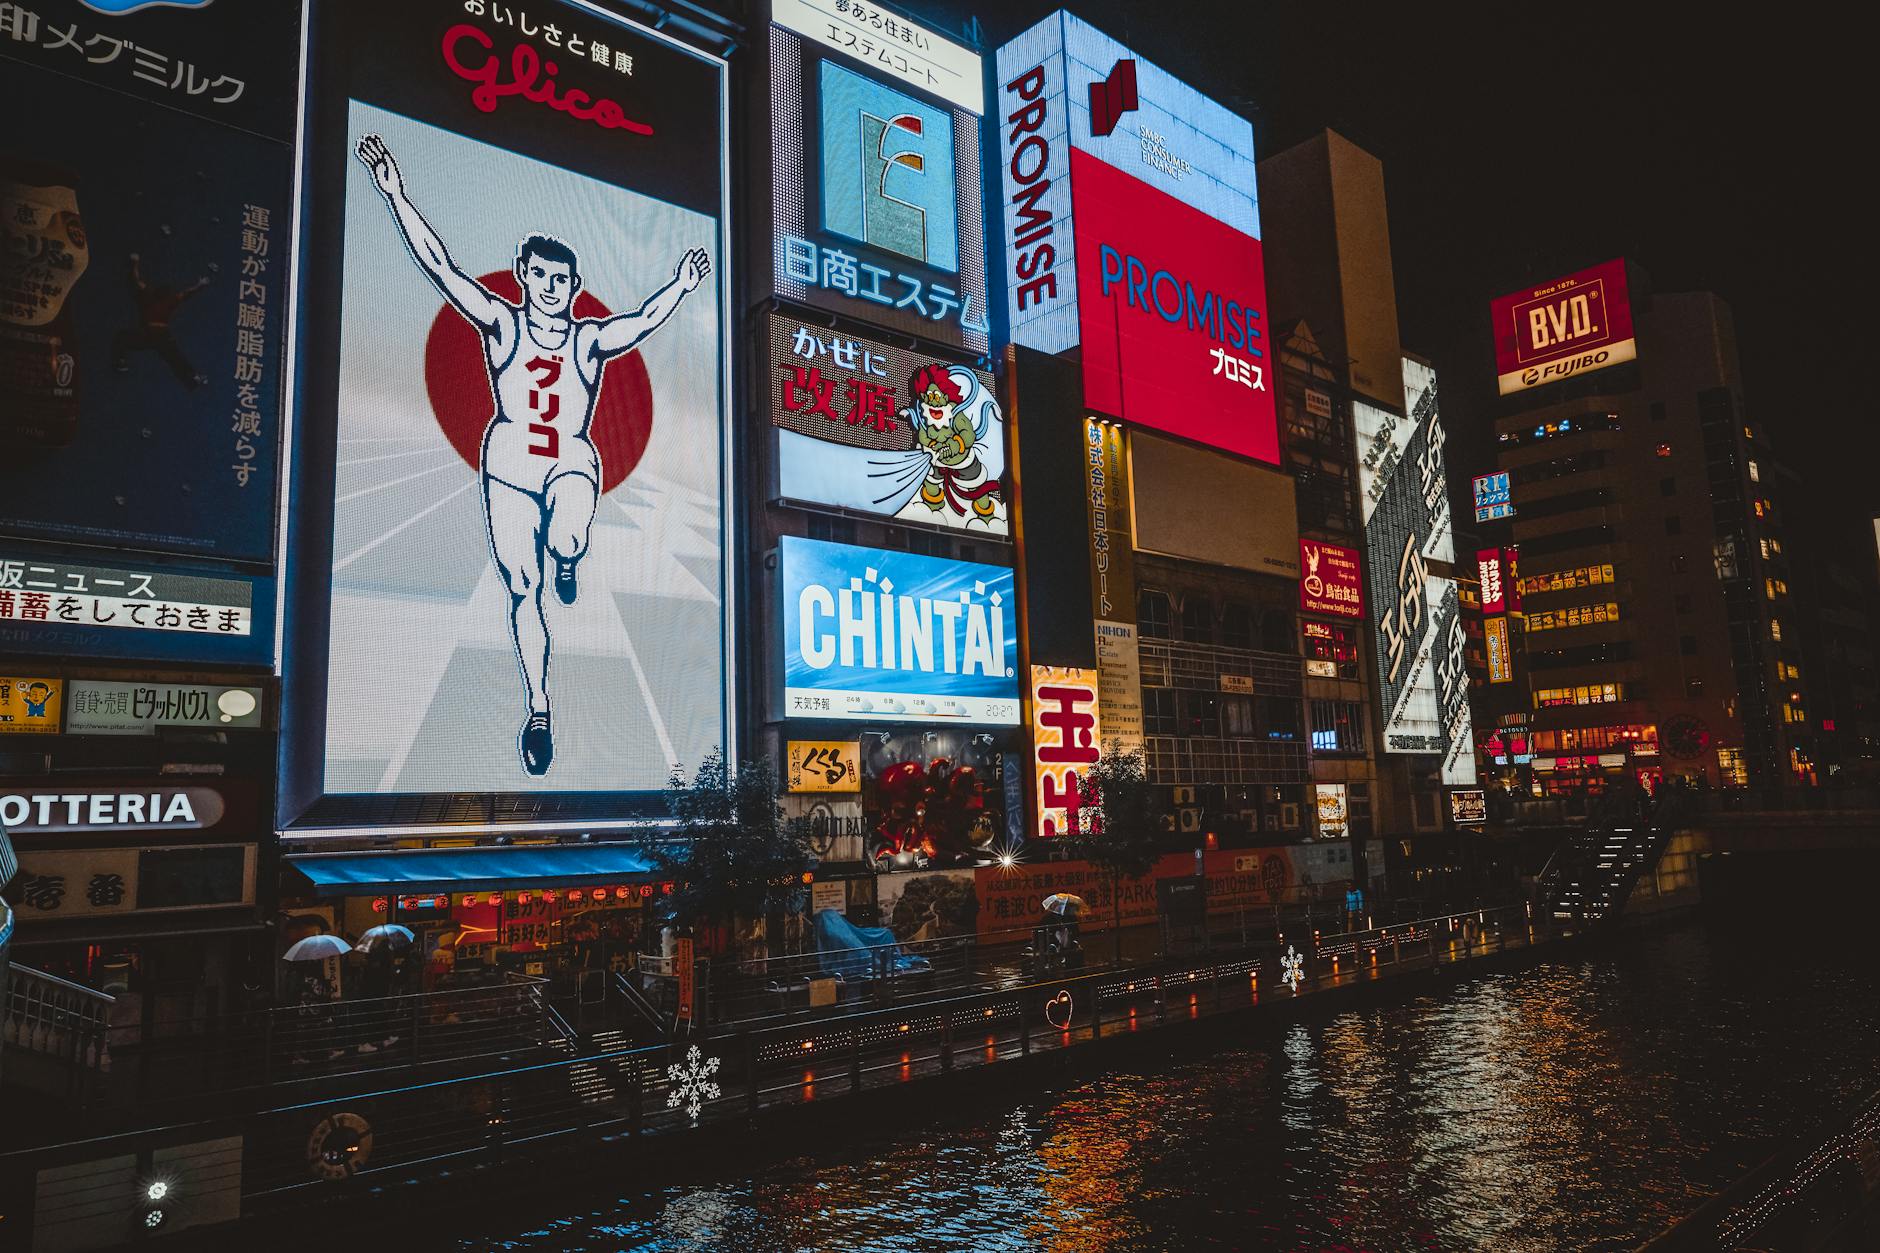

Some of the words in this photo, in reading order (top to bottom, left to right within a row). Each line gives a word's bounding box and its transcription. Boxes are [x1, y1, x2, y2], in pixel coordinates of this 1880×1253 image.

[463, 0, 634, 76] おいしさと健康
[834, 0, 931, 51] 夢ある住まい
[826, 23, 939, 85] エステムコート
[442, 24, 654, 136] Glico
[1140, 125, 1166, 145] SMBC
[1141, 138, 1191, 175] CONSUMER
[1007, 64, 1057, 311] PROMISE
[1141, 150, 1184, 181] FINANCE
[784, 236, 990, 333] 日商エステム
[1100, 243, 1263, 357] PROMISE
[1534, 286, 1555, 298] Since
[231, 203, 271, 487] 運動が内臓脂肪を減らす
[1529, 294, 1598, 349] B.V.D.
[792, 327, 887, 377] かぜに
[1209, 348, 1265, 392] プロミス
[1543, 351, 1608, 377] FUJIBO
[525, 355, 563, 458] グリコ
[780, 363, 898, 433] 改源
[1417, 413, 1446, 495] エイブル
[1479, 561, 1491, 604] JOYSOUND
[1488, 559, 1502, 603] カラオケ
[799, 570, 1006, 677] CHINTAI
[1098, 625, 1131, 638] NIHON
[1381, 532, 1428, 684] エイブル
[1437, 614, 1466, 705] エイブル
[133, 688, 210, 720] ピタットハウス
[794, 696, 830, 711] 天気予報
[986, 704, 1013, 717] 20:27
[802, 748, 846, 785] くくる
[0, 793, 196, 827] OTTERIA
